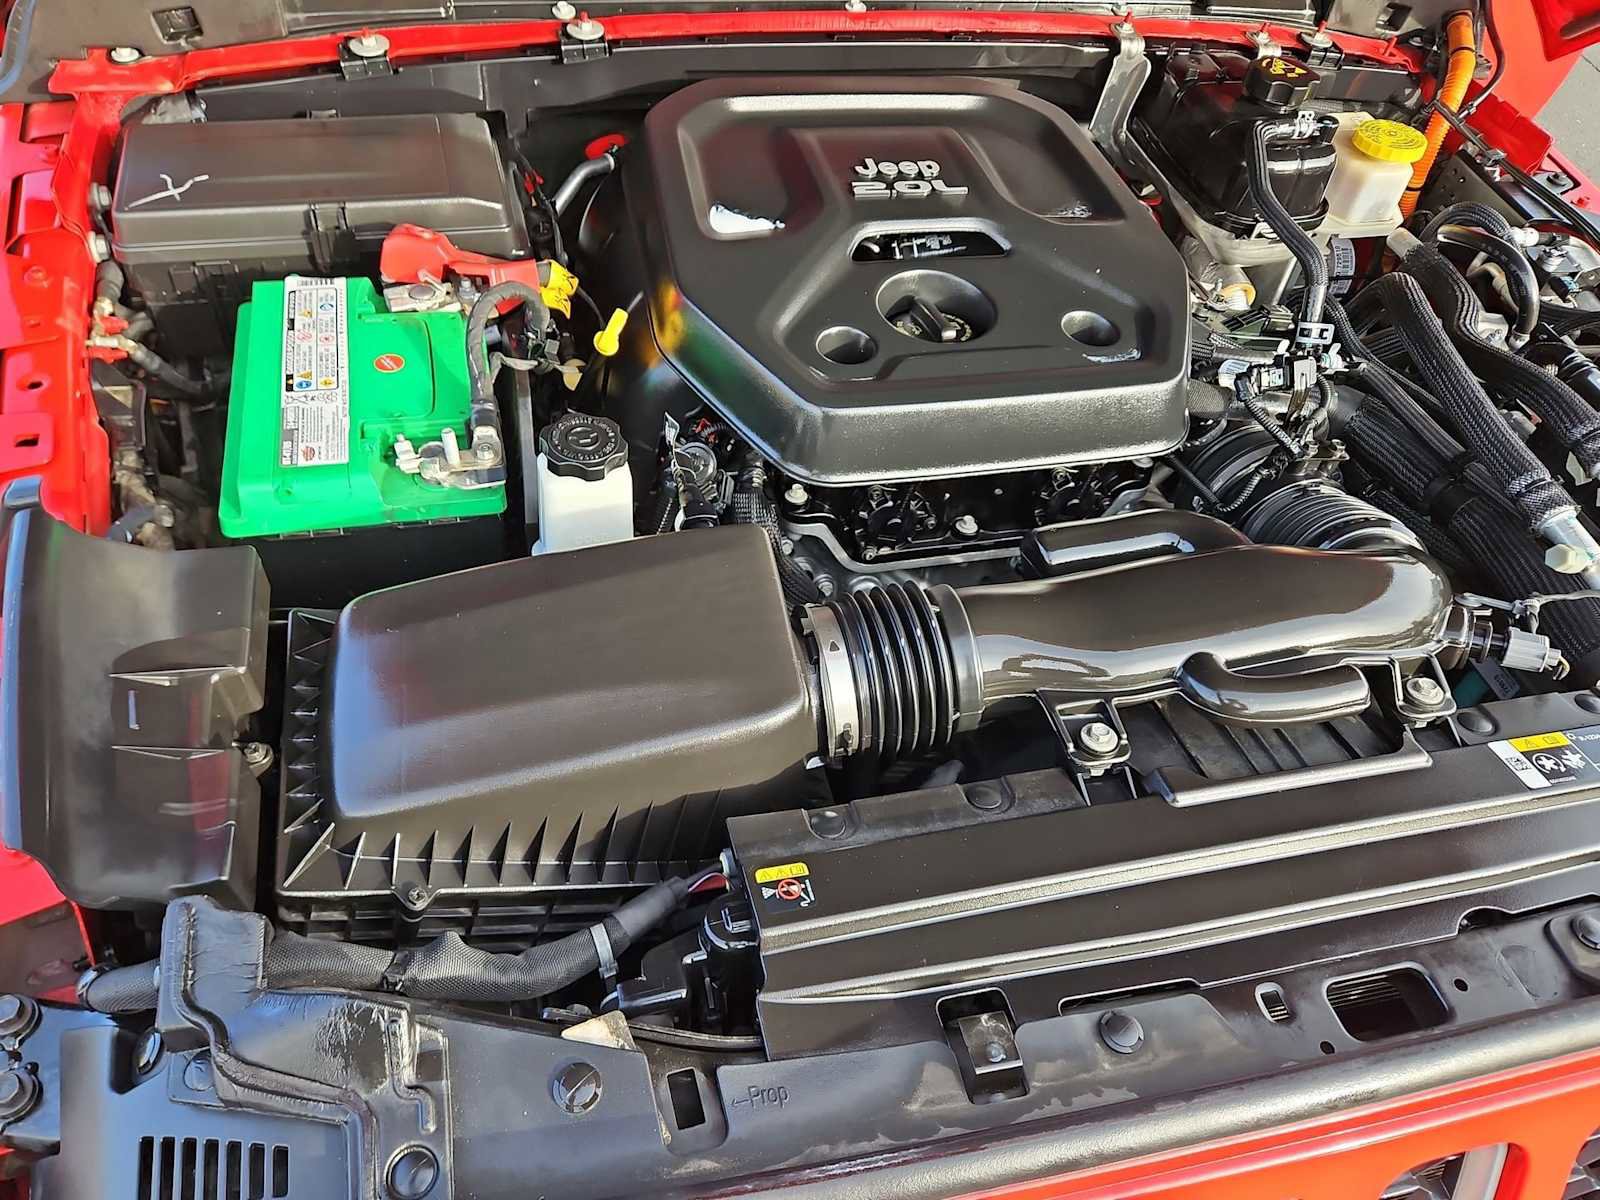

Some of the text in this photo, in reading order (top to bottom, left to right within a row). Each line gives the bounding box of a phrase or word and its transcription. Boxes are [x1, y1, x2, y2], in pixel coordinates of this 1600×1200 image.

[854, 157, 940, 178] Jeep
[851, 179, 969, 199] 2.0L
[747, 1085, 790, 1109] Prop
